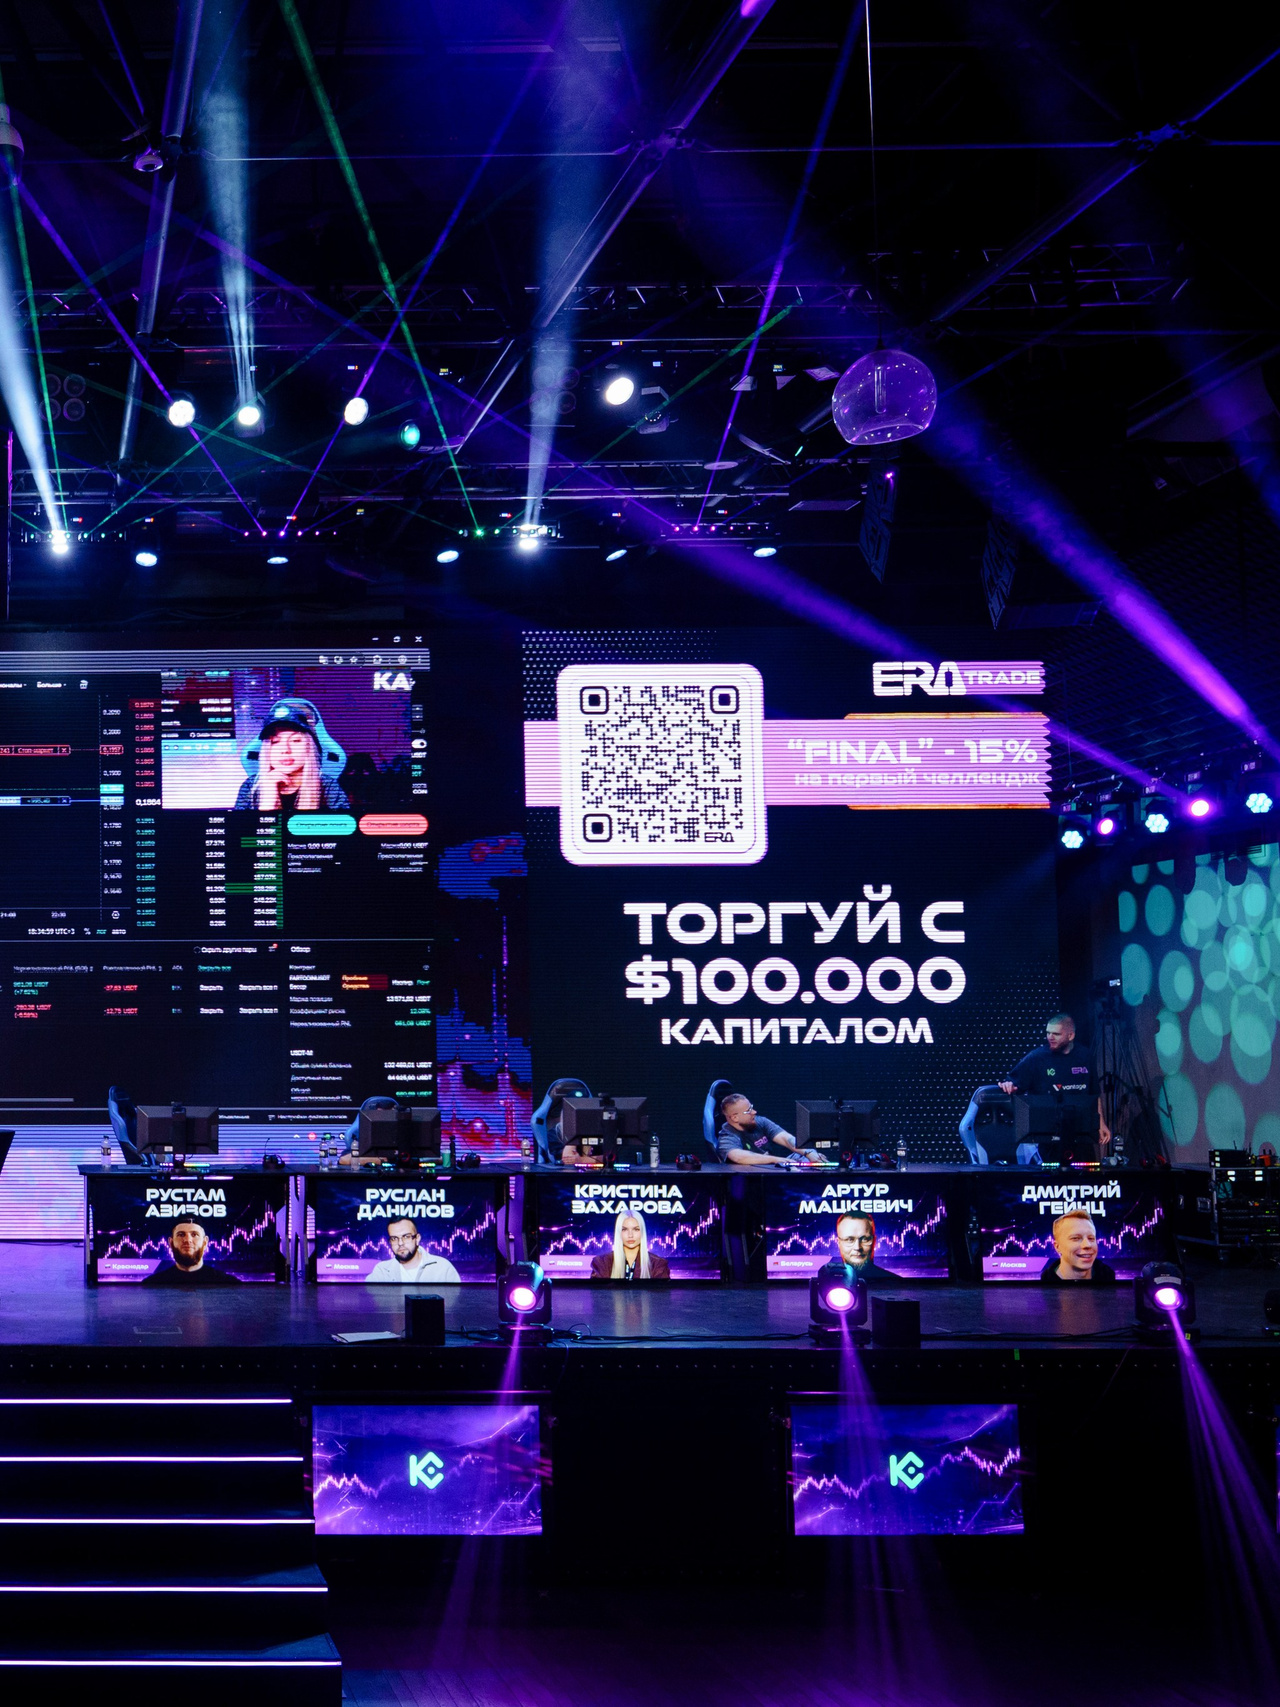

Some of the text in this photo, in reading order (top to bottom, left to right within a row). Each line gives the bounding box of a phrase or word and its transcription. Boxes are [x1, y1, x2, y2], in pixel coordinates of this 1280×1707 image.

[872, 661, 1041, 696] ERA TRADE
[963, 739, 1038, 764] 15%
[794, 768, 1040, 788] на первый челлендж
[704, 832, 735, 842] ERA
[623, 884, 966, 945] ТОРГУЙ С
[624, 955, 967, 1005] $100.000
[661, 1017, 934, 1045] КАПИТАЛОМ
[146, 1188, 226, 1203] РУСТАМ
[366, 1188, 446, 1203] РУСЛАН
[574, 1184, 683, 1198] КРИСТИНА
[822, 1183, 889, 1198] АРТУР
[1022, 1180, 1121, 1202] ДМИТРИЙ
[357, 1203, 454, 1220] ДАНИЛОВ
[572, 1200, 686, 1214] ЗАХАРОВА
